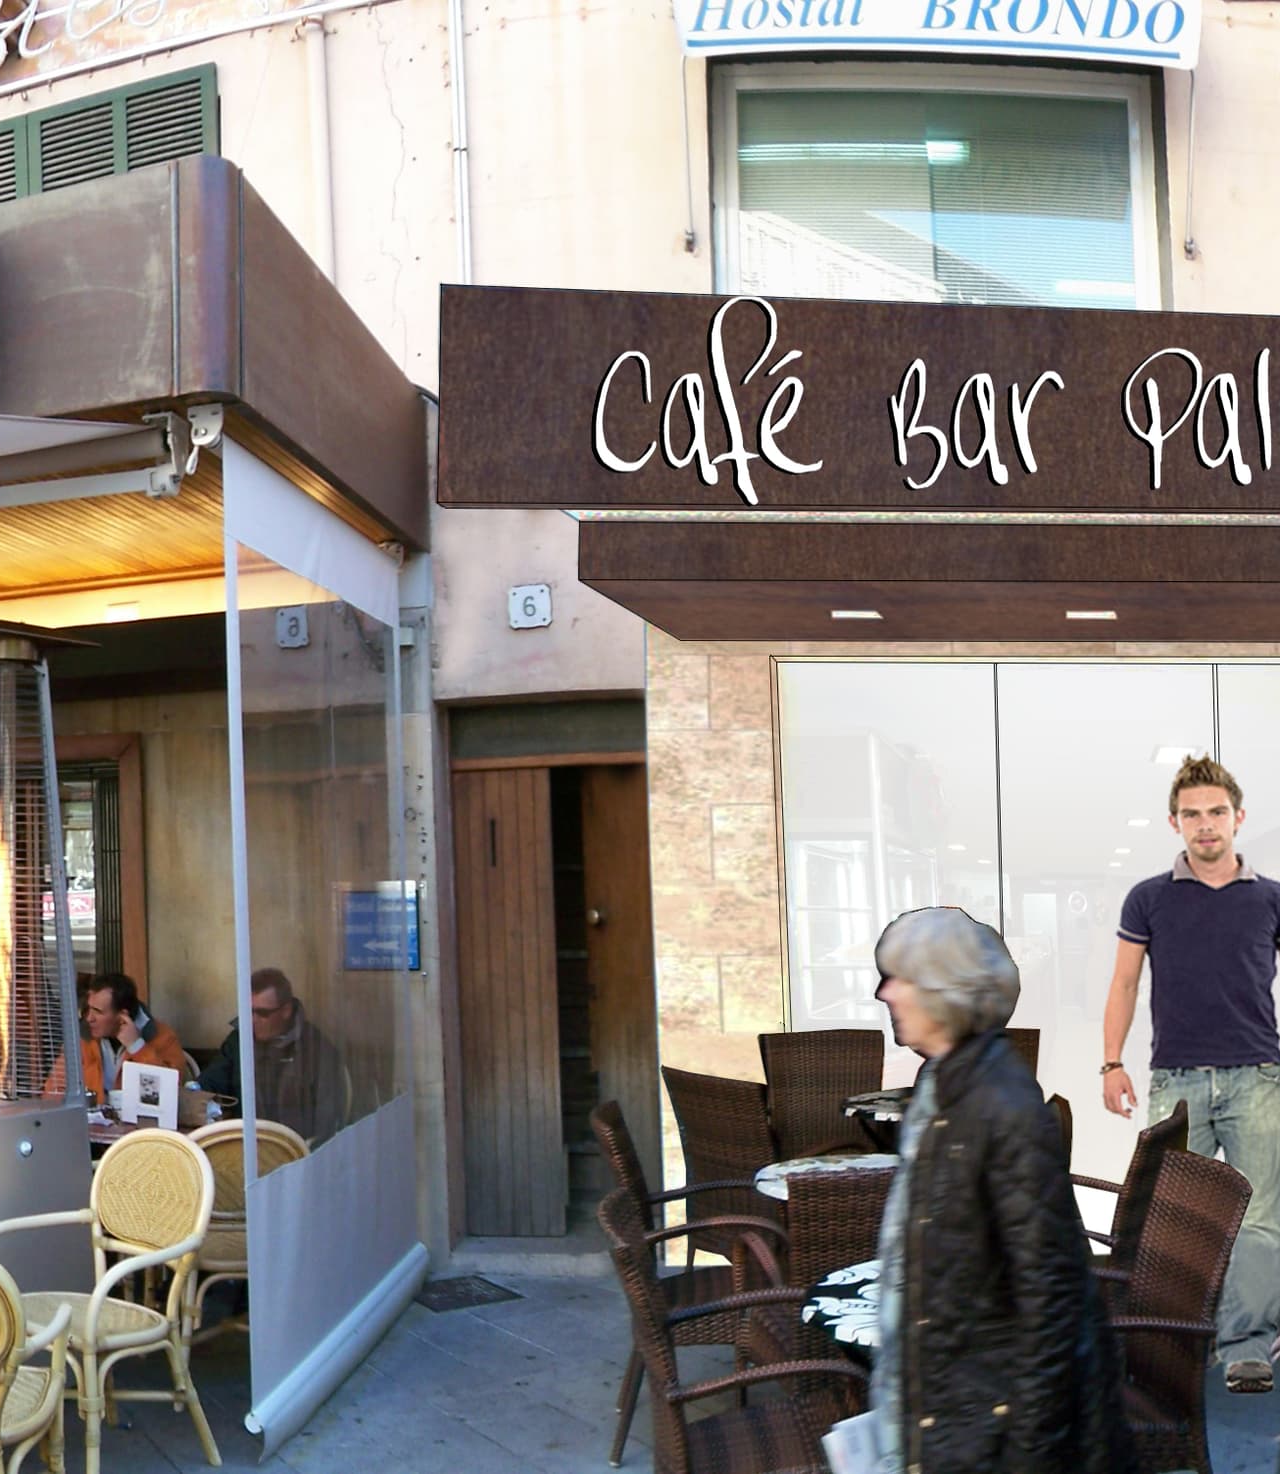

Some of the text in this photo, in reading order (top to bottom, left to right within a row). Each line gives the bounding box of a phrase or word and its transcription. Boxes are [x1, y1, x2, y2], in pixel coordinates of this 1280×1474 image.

[692, 0, 1187, 45] Hostal BRONDO
[594, 296, 823, 506] Café
[890, 358, 1065, 490] Bar
[522, 595, 537, 617] 6
